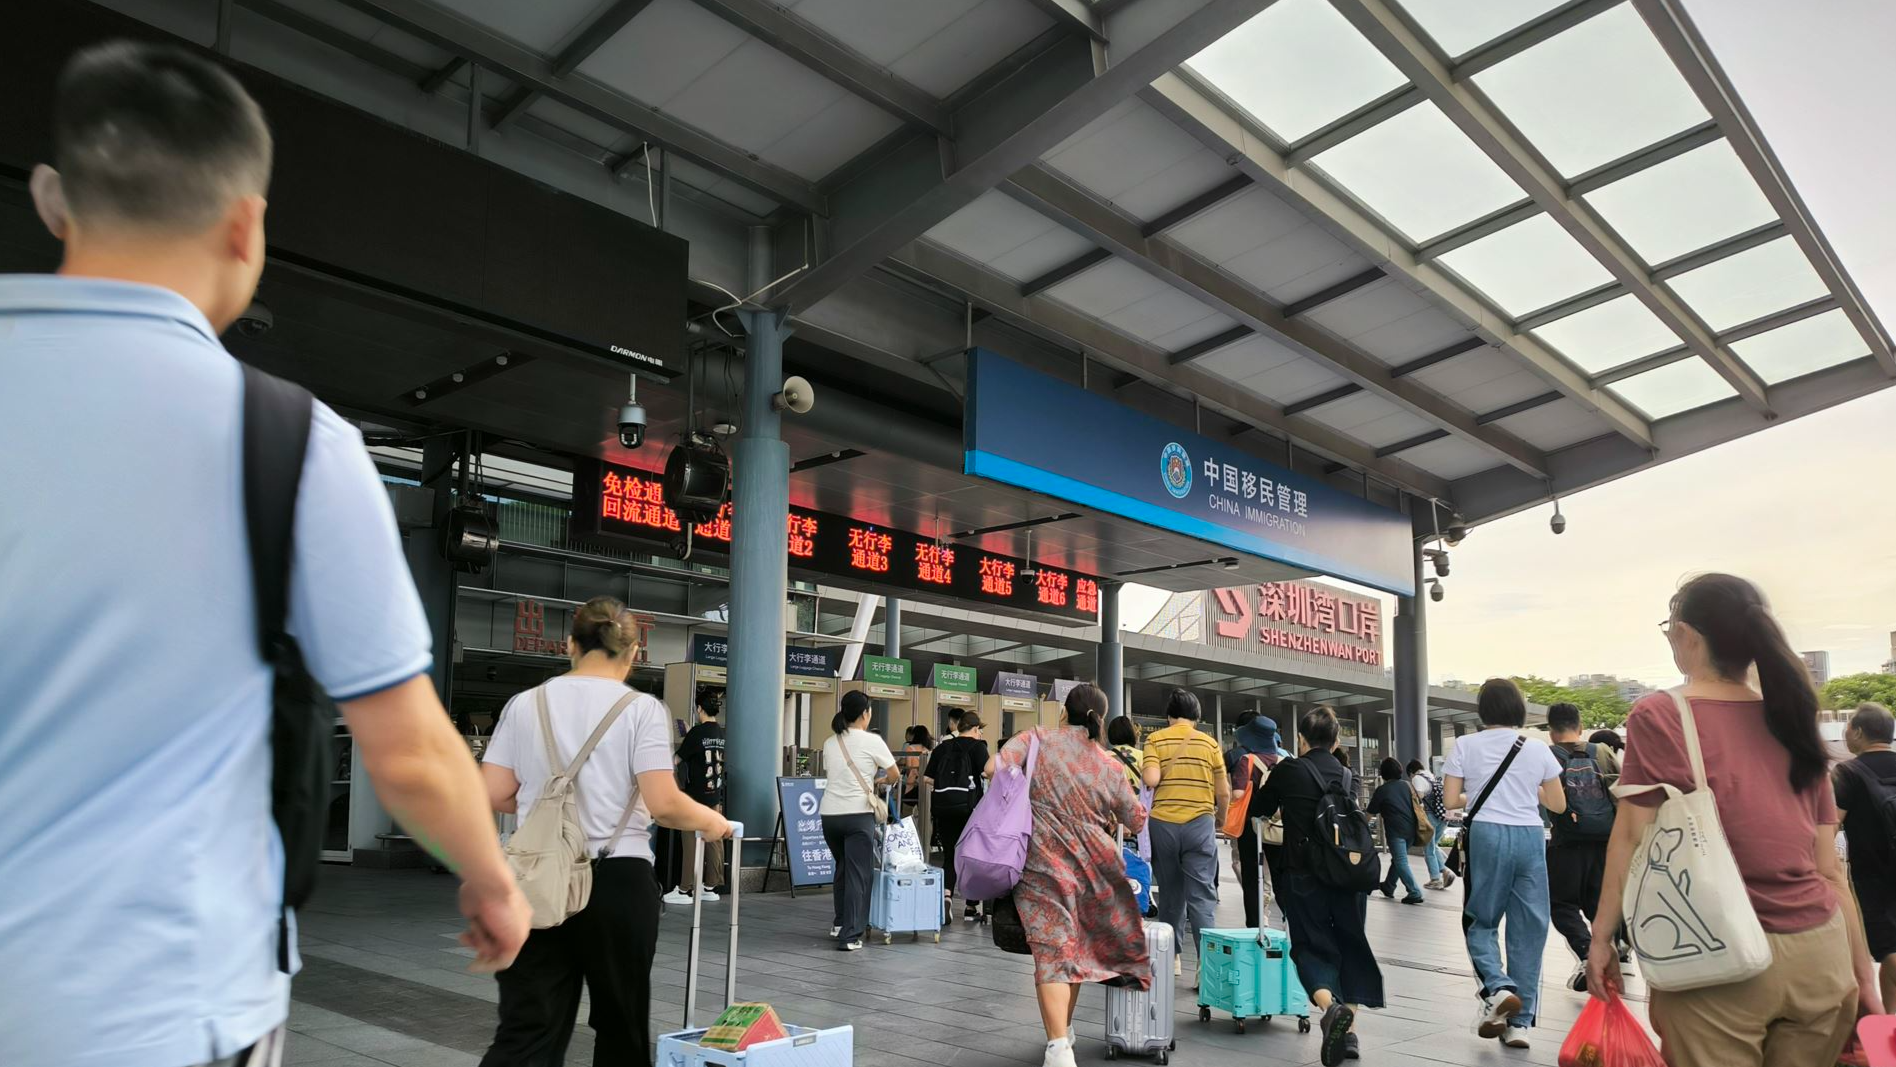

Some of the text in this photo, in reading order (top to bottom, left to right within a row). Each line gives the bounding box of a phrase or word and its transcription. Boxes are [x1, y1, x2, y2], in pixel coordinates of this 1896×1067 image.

[602, 471, 664, 505] 免检通
[1204, 457, 1308, 518] 中国移民管理
[602, 495, 681, 531] 回流通道
[1208, 494, 1306, 537] CHINA IMMIGRATION
[848, 528, 892, 554] 无行李
[851, 549, 889, 572] 通道3
[915, 543, 955, 567] 无行李
[917, 562, 952, 584] 通道4
[979, 556, 1015, 579] 大行李
[1035, 568, 1068, 590] 大行李
[981, 577, 1012, 596] 通道5
[1038, 585, 1066, 606] 通道6
[1076, 594, 1097, 613] 通道
[1257, 582, 1380, 643] 深圳湾口岸
[789, 652, 826, 665] 大行李通道
[1260, 628, 1382, 666] SHENZHENWAN PORT
